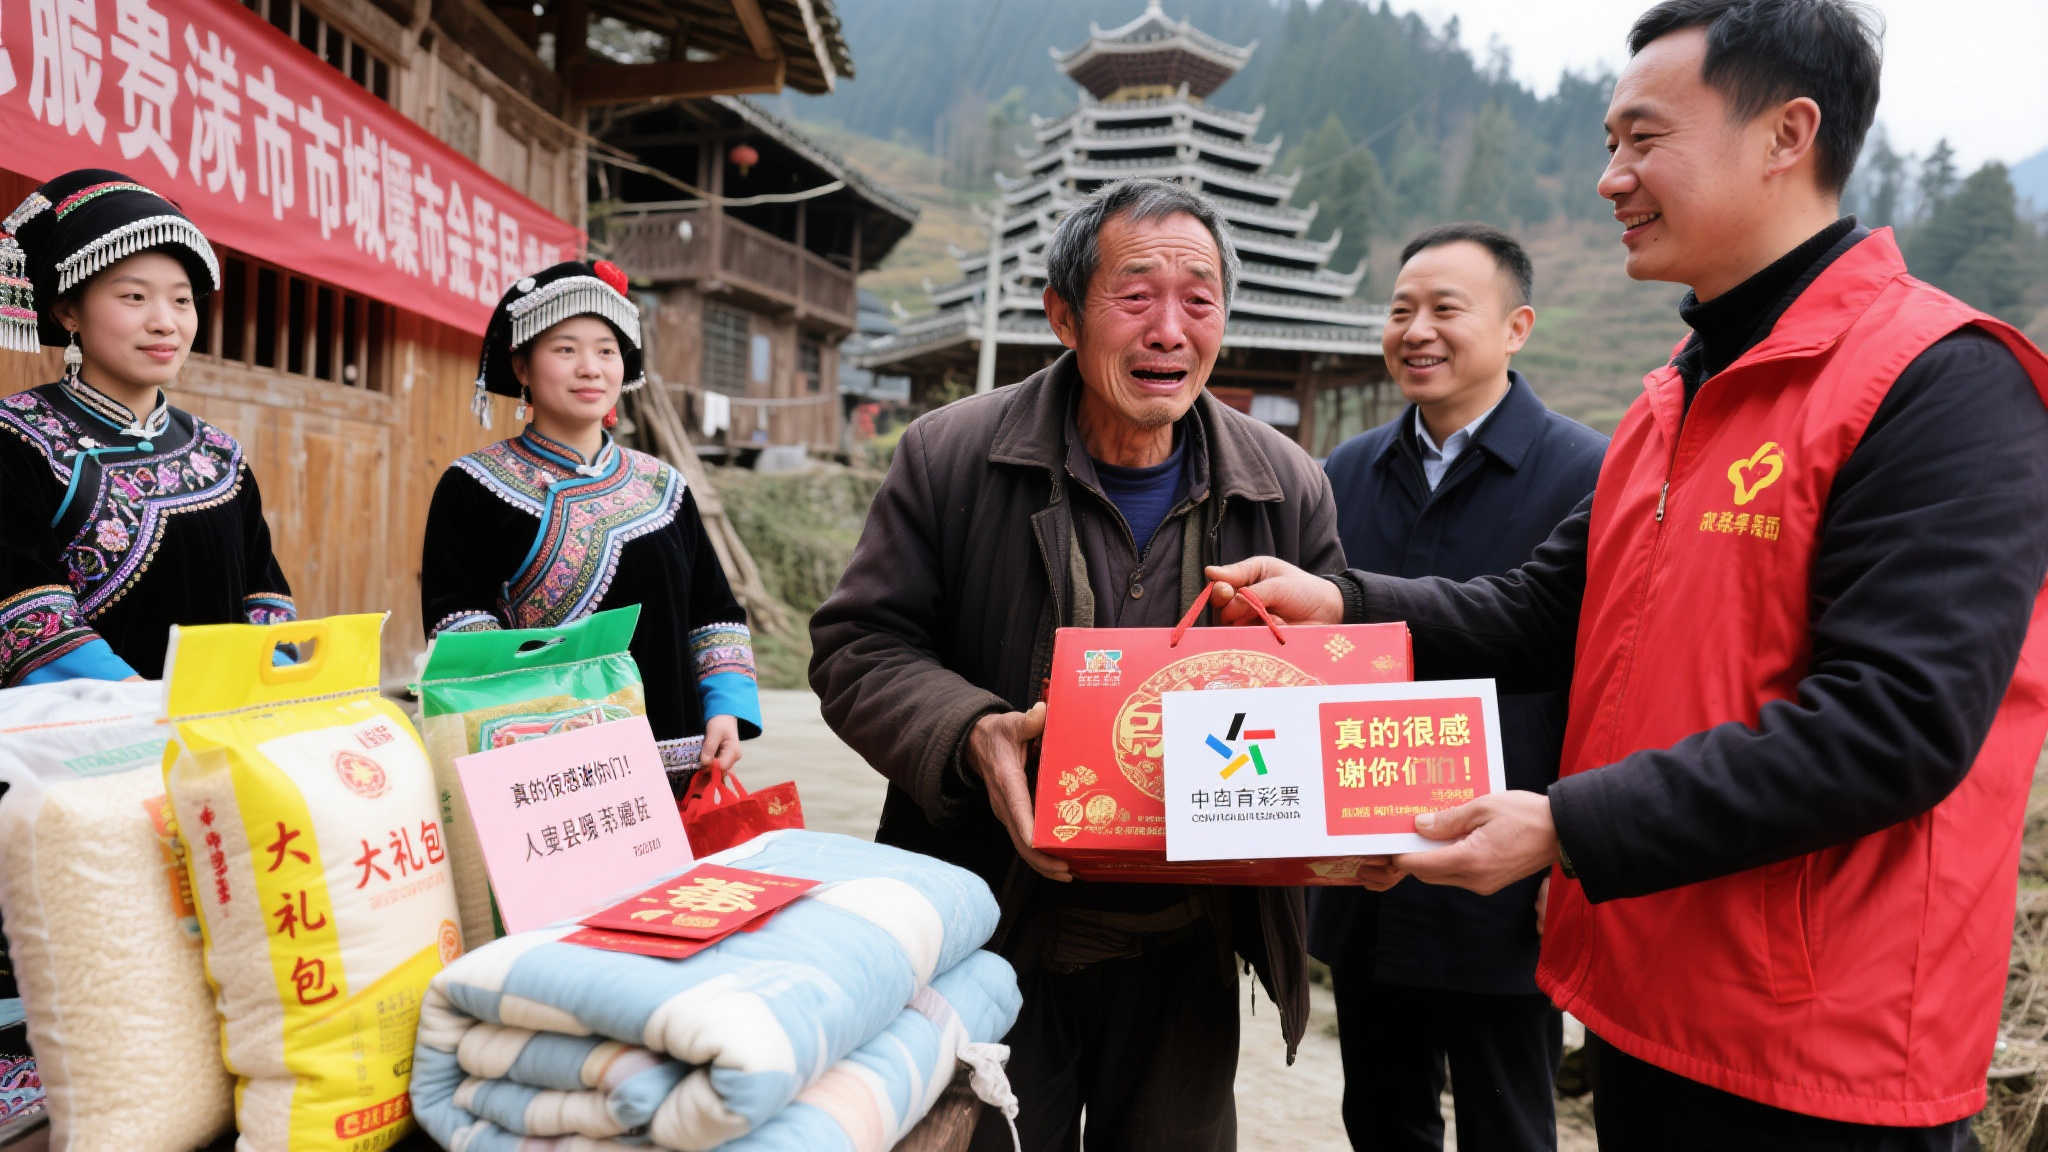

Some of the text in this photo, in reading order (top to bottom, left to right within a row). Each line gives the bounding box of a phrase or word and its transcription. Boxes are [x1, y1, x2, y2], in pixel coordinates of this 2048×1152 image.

[1334, 713, 1471, 750] 真的很感
[353, 819, 445, 889] 大礼包
[266, 820, 339, 1006] 大礼包
